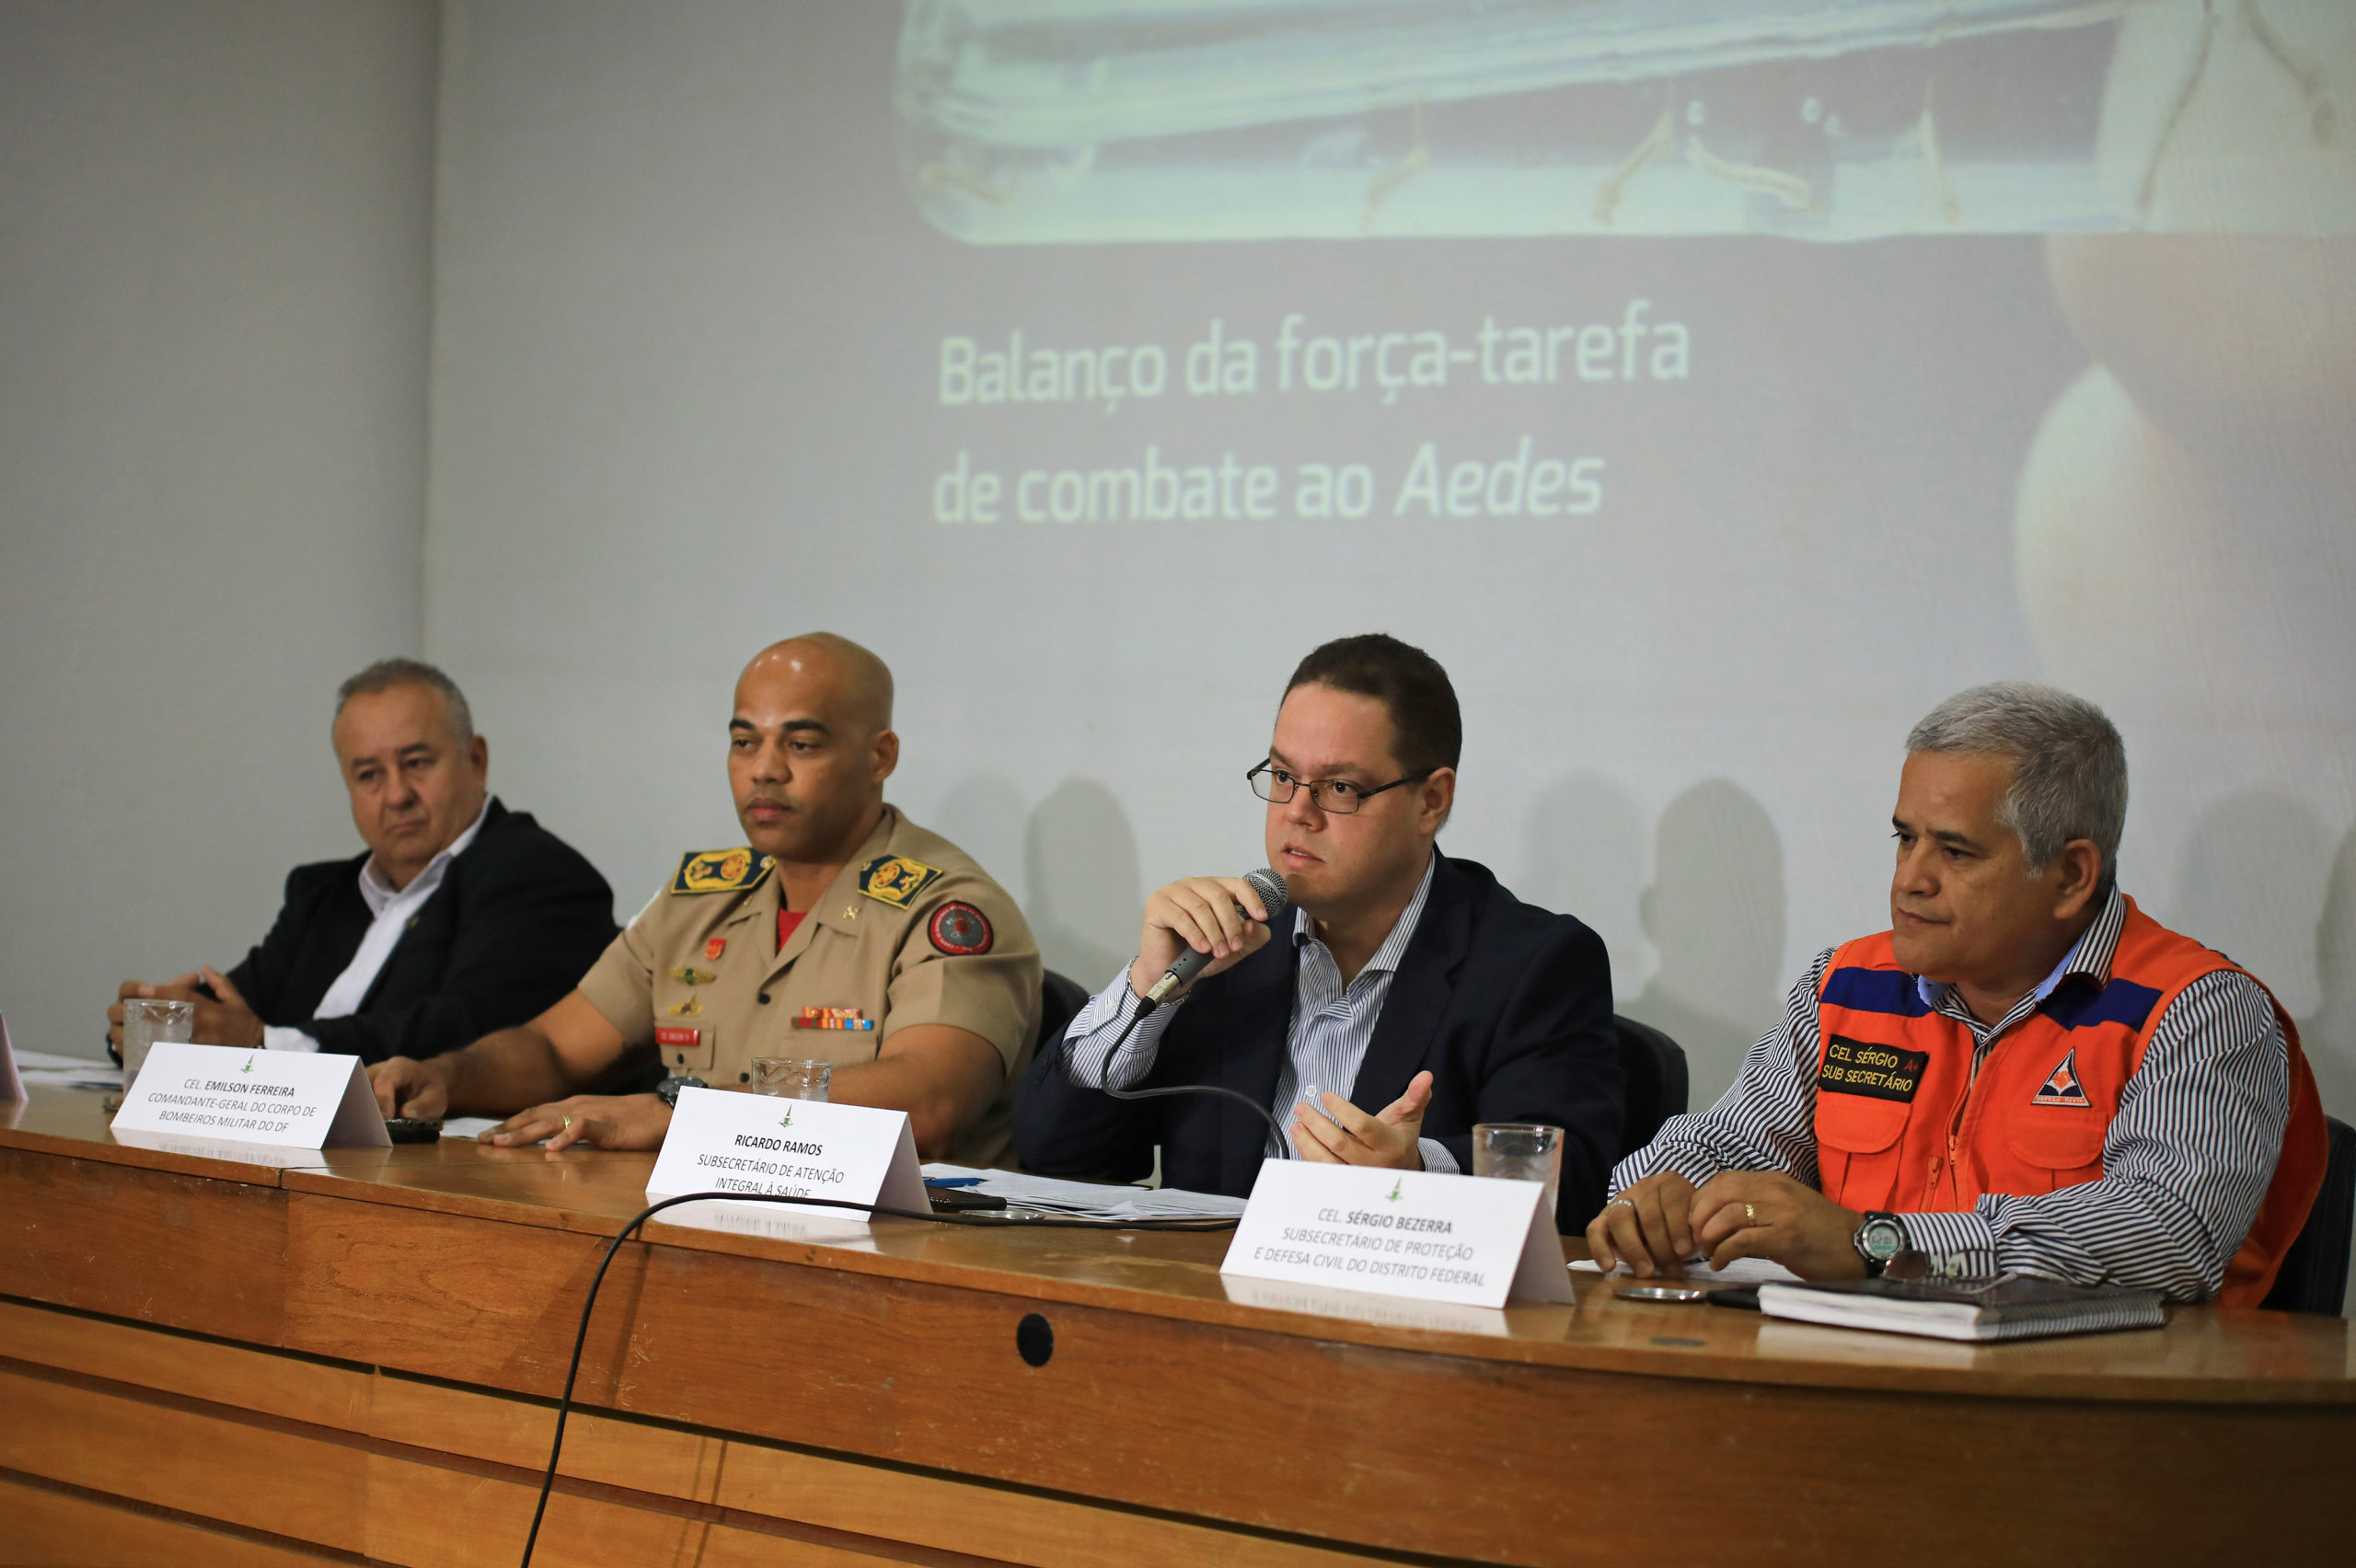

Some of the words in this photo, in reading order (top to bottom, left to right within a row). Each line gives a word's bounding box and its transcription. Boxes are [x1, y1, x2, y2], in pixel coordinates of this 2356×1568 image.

[939, 328, 1168, 414] Balanço
[1185, 317, 1257, 396] da
[1275, 298, 1690, 404] força-tarefa
[933, 451, 1001, 525] de
[1016, 444, 1278, 525] combate
[1296, 462, 1373, 519] ao
[1392, 433, 1606, 518] Aedes
[1830, 1044, 1852, 1062] CEL
[1855, 1046, 1899, 1068] SÉRGIO
[184, 1078, 202, 1090] CEL.
[204, 1080, 249, 1094] EMILSON
[249, 1084, 295, 1098] FERREIRA
[1822, 1065, 1844, 1080] SUB
[1844, 1071, 1912, 1091] SECRETÁRIO
[148, 1092, 248, 1112] COMANDANTE-GERAL
[250, 1101, 266, 1113] DO
[267, 1103, 301, 1116] CORPO
[302, 1106, 317, 1117] DE
[158, 1110, 215, 1126] BOMBEIROS
[216, 1116, 257, 1130] MILITAR
[258, 1120, 273, 1132] DO
[274, 1122, 290, 1133] DF
[734, 1134, 781, 1151] RICARDO
[782, 1140, 824, 1156] RAMOS
[697, 1153, 778, 1175] SUBSECRETÁRIO
[779, 1164, 794, 1177] DE
[794, 1166, 845, 1184] ATENÇÃO
[715, 1177, 763, 1194] INTEGRAL
[765, 1181, 773, 1196] À
[1318, 1207, 1342, 1223] CEL.
[1345, 1209, 1393, 1228] SÉRGIO
[1395, 1216, 1453, 1234] BEZERRA
[1281, 1227, 1382, 1251] SUBSECRETÁRIO
[1384, 1239, 1403, 1253] DE
[1403, 1240, 1473, 1262] PROTEÇÃO
[1253, 1247, 1264, 1260] E
[1264, 1248, 1310, 1265] DEFESA
[1312, 1253, 1343, 1270] CIVIL
[1345, 1258, 1368, 1273] DO
[1369, 1261, 1427, 1280] DISTRITO
[1429, 1267, 1486, 1287] FEDERAL
